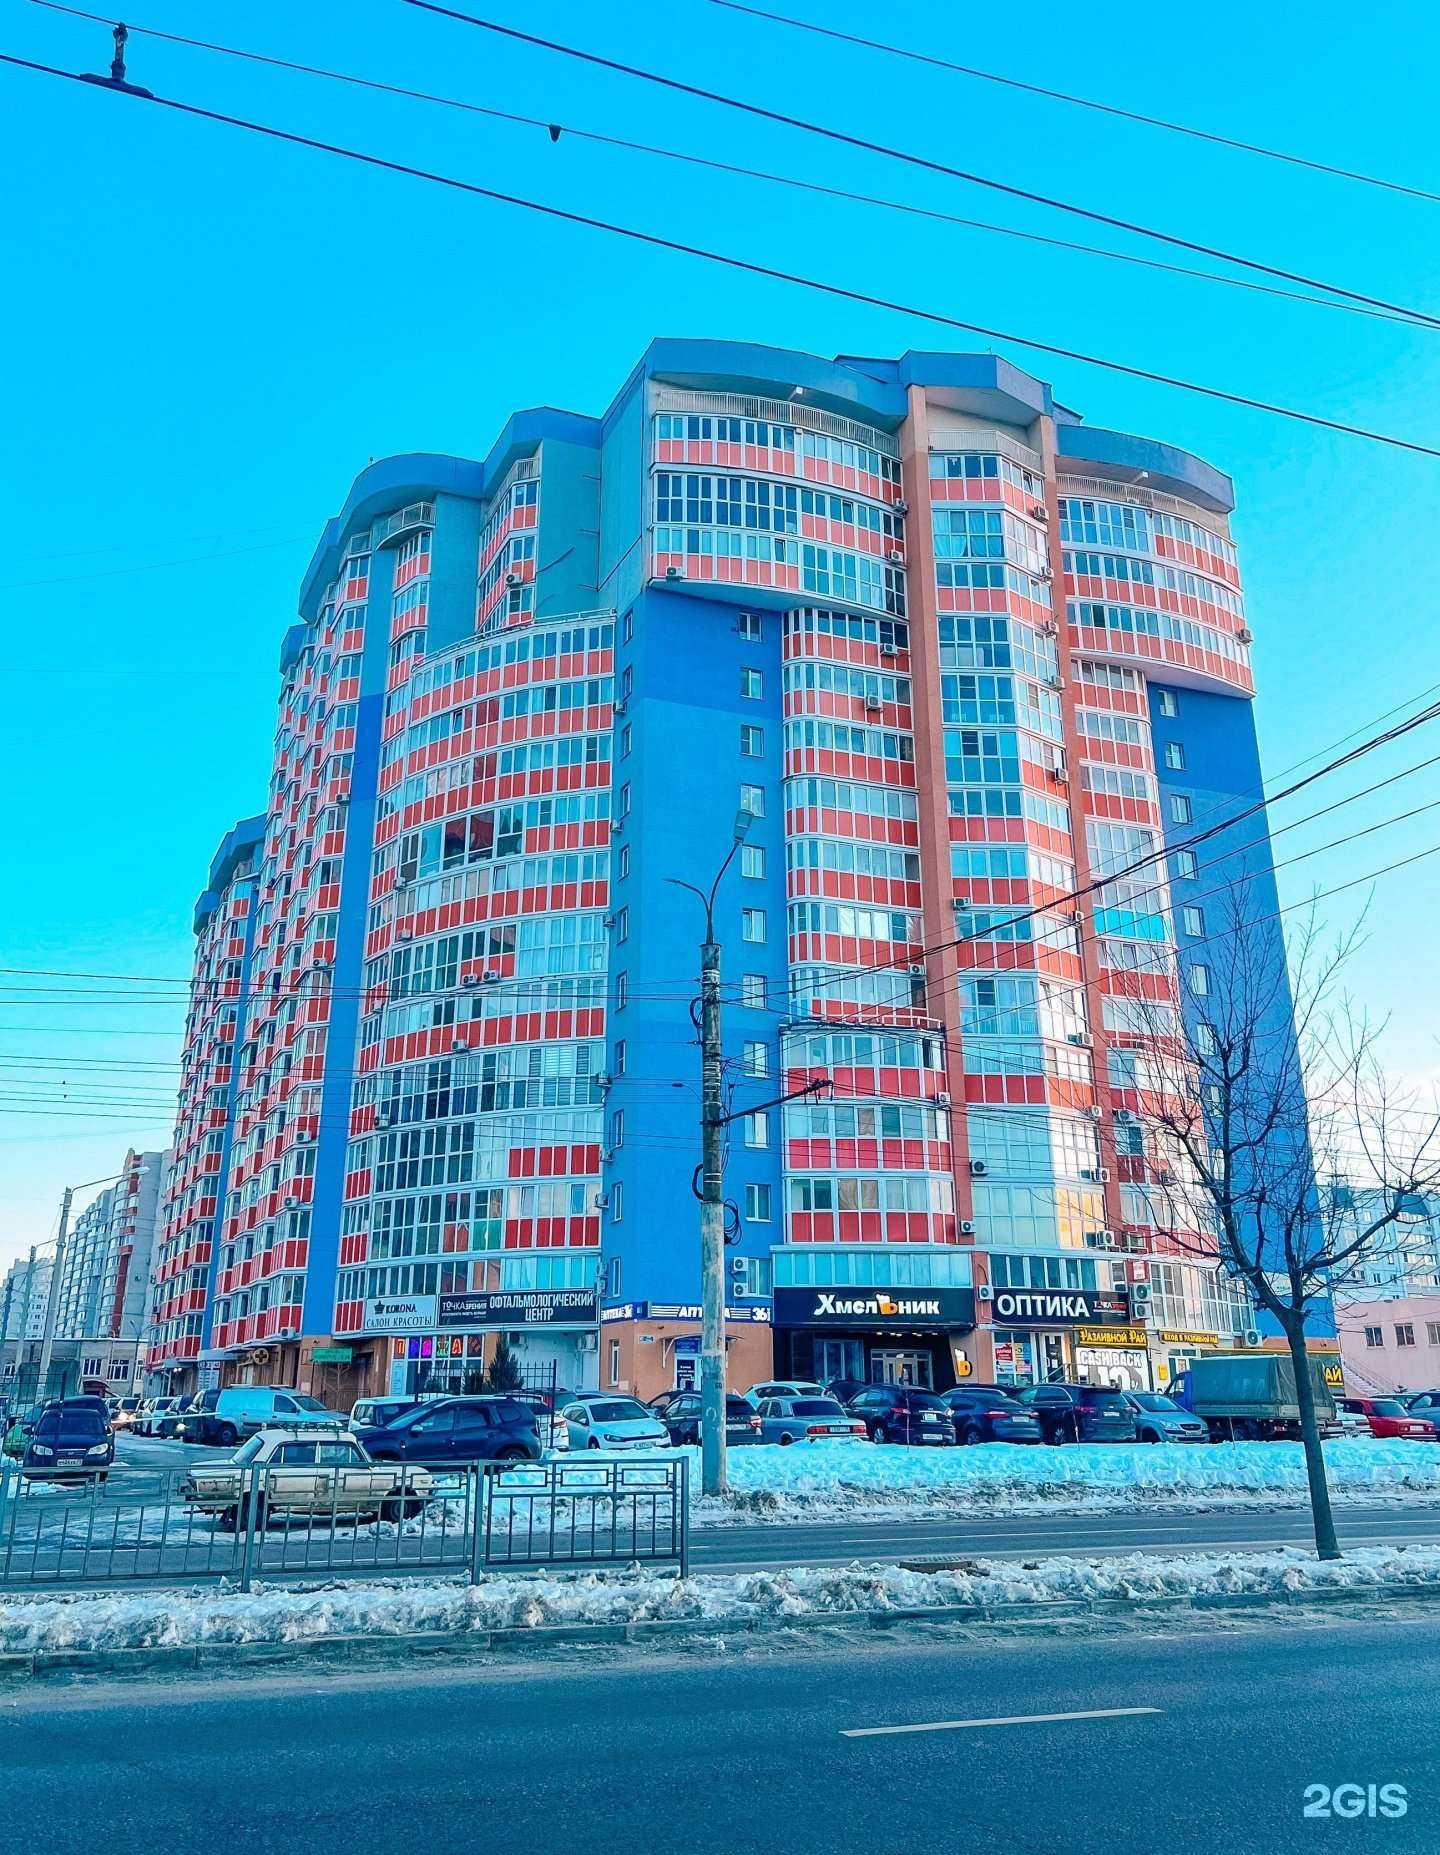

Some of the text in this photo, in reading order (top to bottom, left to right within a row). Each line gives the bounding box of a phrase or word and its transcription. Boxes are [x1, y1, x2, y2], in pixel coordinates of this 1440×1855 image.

[489, 1291, 594, 1309] ОФТАЛЬМОЛОГИЧЕСКИЙ
[814, 1294, 940, 1315] Хмельник
[997, 1294, 1090, 1318] ОПТИКА
[367, 1315, 432, 1328] САЛОН КРАСОТЫ
[525, 1308, 554, 1323] ЦЕНТР
[1081, 1350, 1141, 1368] CASH BACK
